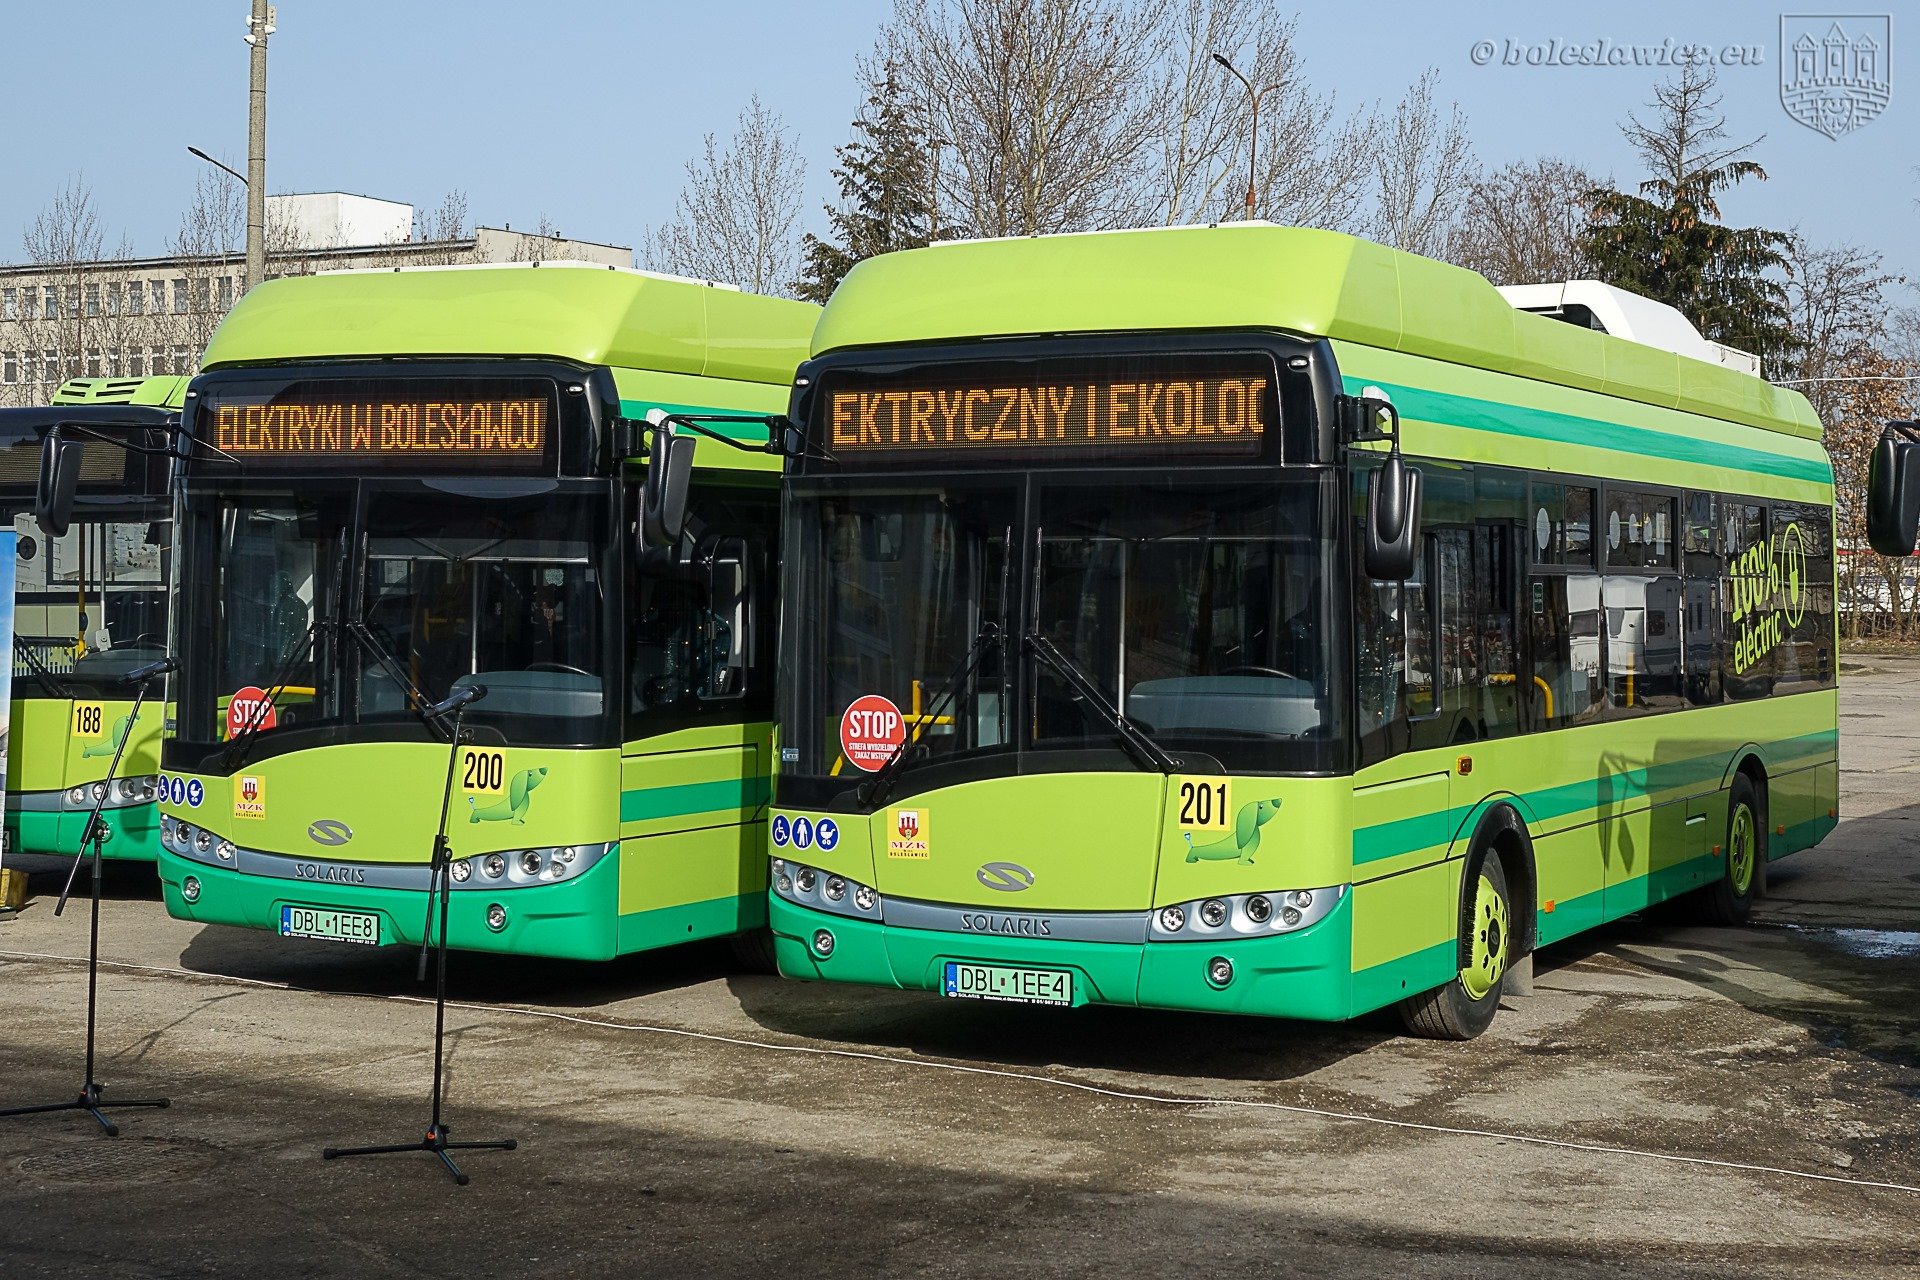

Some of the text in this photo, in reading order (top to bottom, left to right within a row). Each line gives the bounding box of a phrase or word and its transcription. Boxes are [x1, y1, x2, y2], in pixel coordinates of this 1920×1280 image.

[218, 402, 540, 450] ELEKTRYKI W BOLESŁAWCU
[832, 385, 1074, 444] EKTRYCZNY
[1087, 385, 1096, 438] I
[1730, 534, 1779, 623] 100%
[1734, 604, 1782, 675] electric
[77, 706, 101, 733] 188
[849, 710, 897, 739] STOP
[463, 752, 503, 790] 200
[1180, 782, 1226, 825] 201
[891, 841, 926, 849] MZK
[295, 863, 365, 883] SOLARIS
[293, 910, 372, 938] DBL 1EE8
[961, 914, 1051, 936] SOLARIS
[948, 980, 957, 988] PL
[961, 967, 1065, 998] DBL 1EE4
